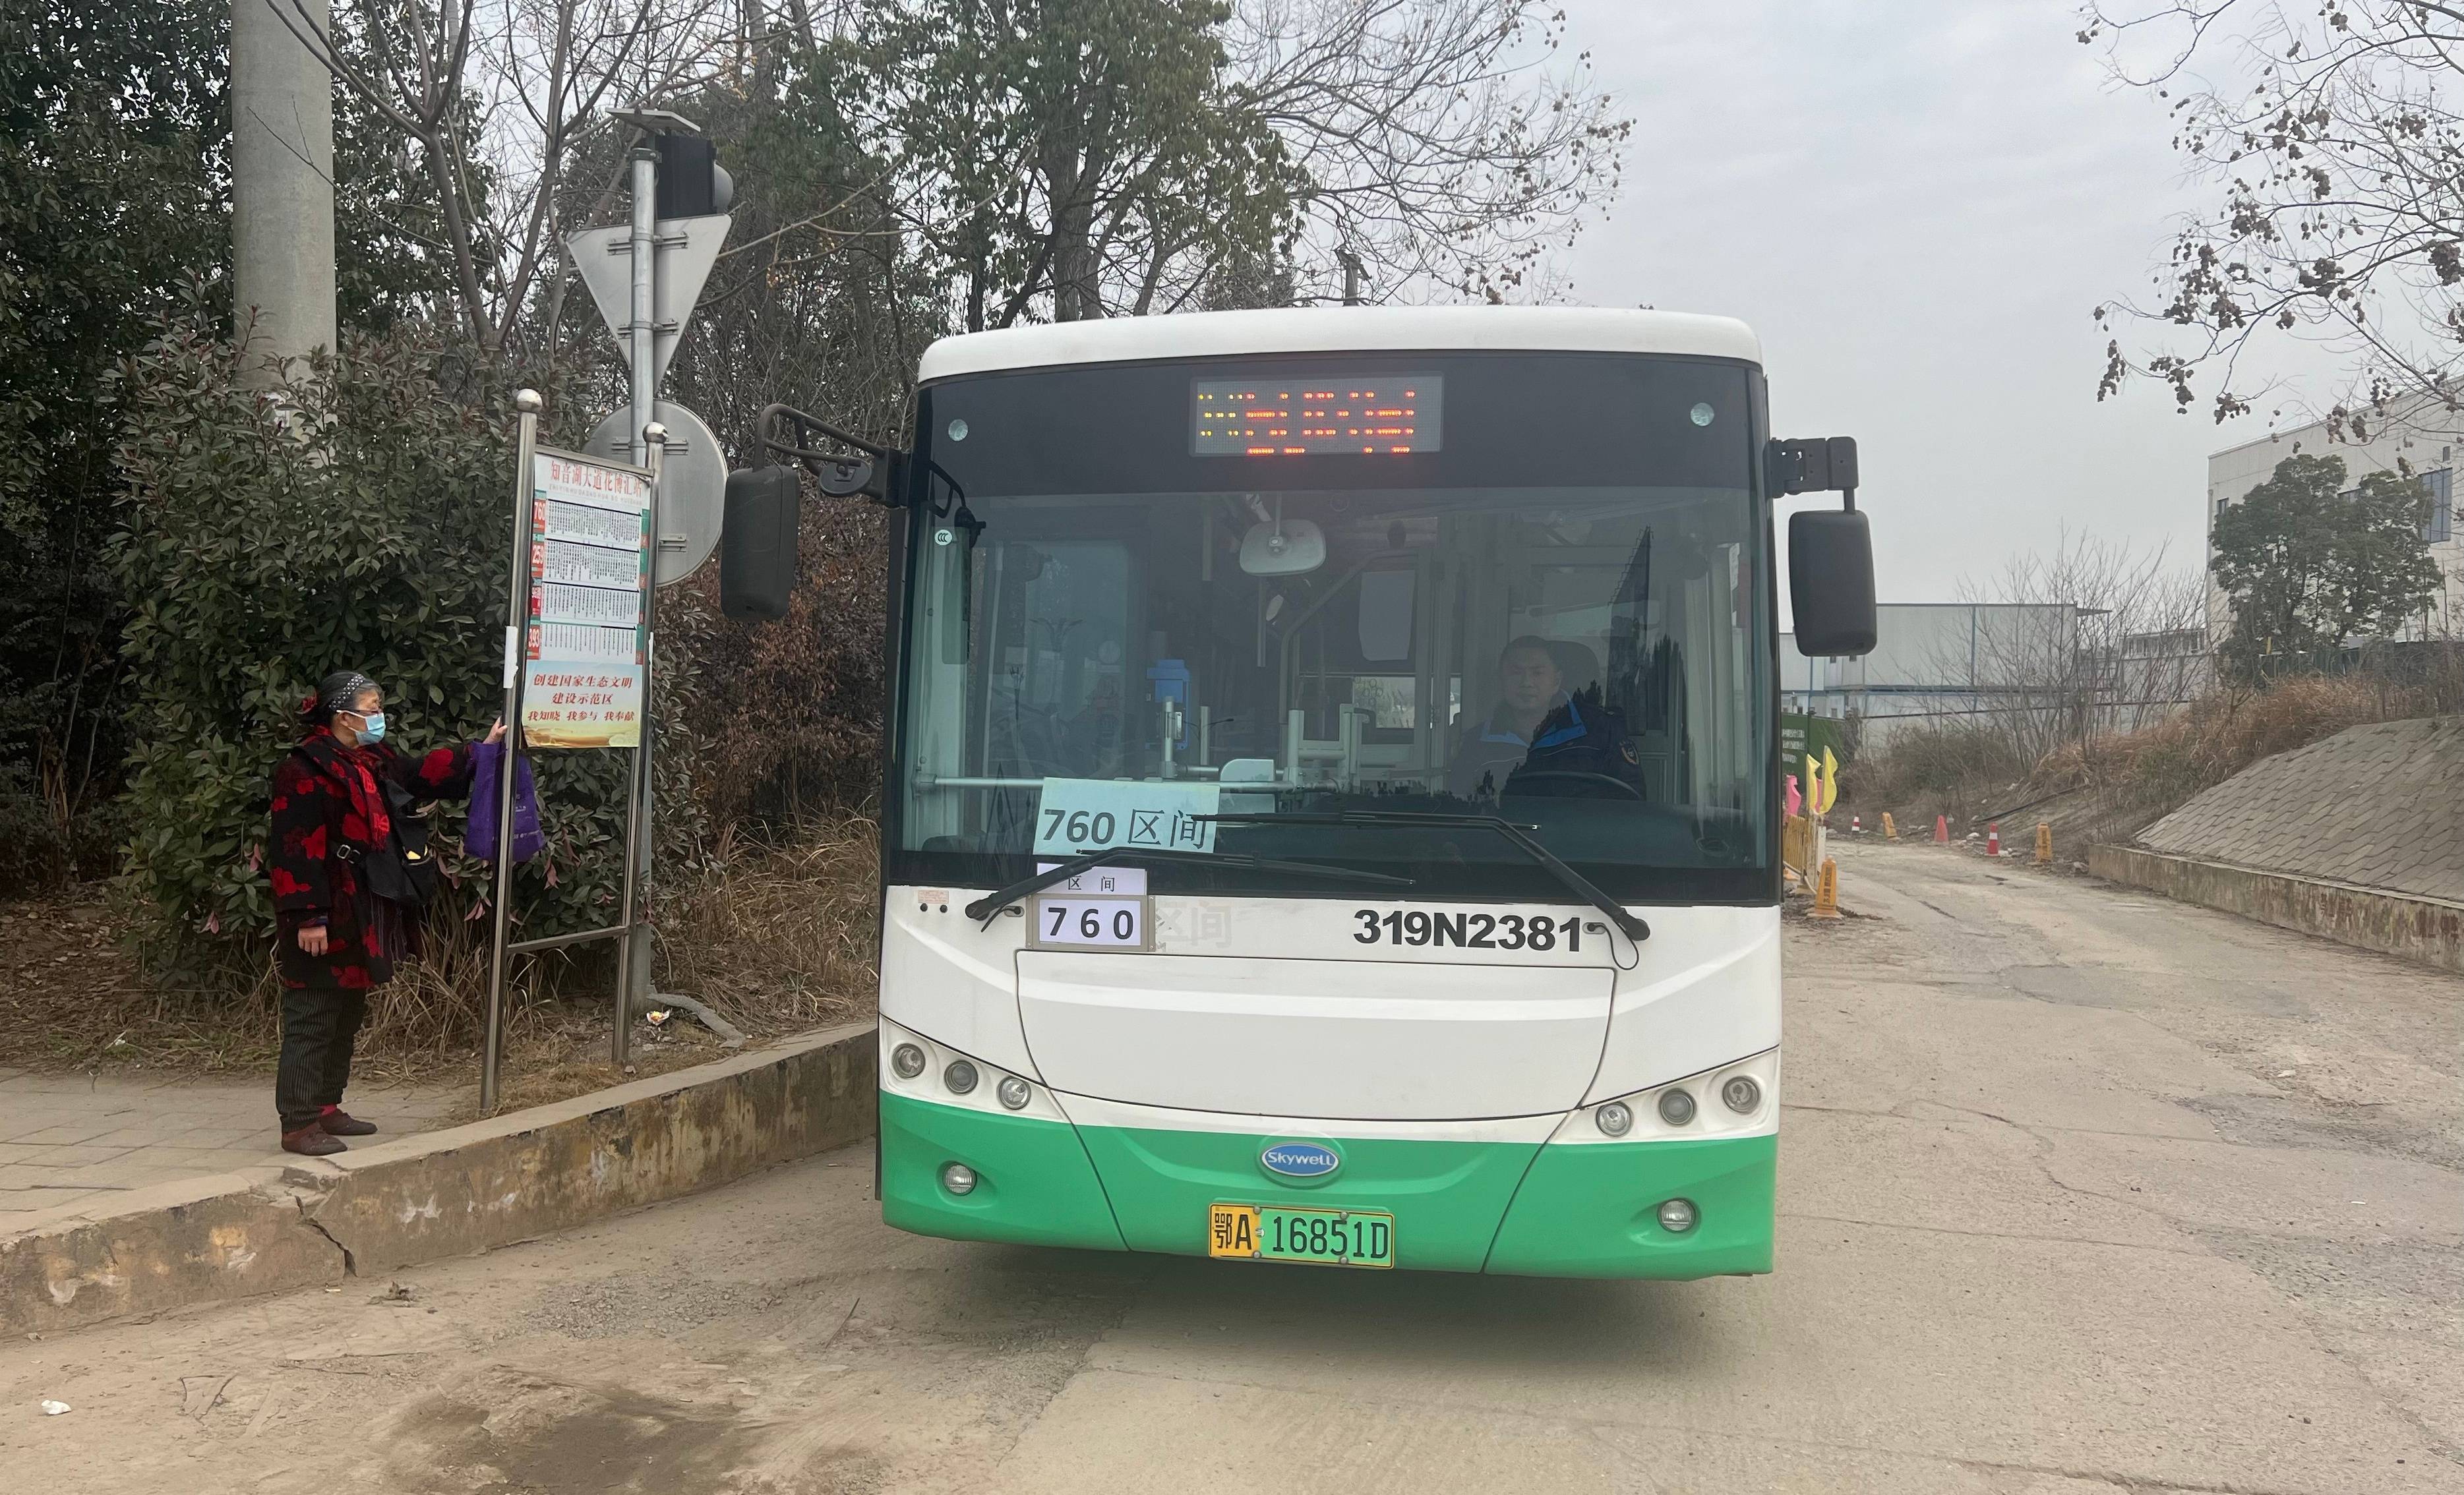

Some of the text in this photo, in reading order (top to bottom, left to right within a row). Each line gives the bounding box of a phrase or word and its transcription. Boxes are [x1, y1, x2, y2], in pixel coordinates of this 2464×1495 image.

[551, 461, 642, 497] 知音湖大道花博汇站
[535, 502, 545, 521] 760
[528, 628, 539, 647] 393
[533, 674, 634, 689] 创建国家生态文明
[552, 692, 613, 705] 建设示范区
[527, 711, 635, 721] 我知晓 我参与 我奉献
[1043, 808, 1206, 849] 760 区间
[1048, 907, 1133, 940] 760
[1353, 909, 1580, 952] 319N2381
